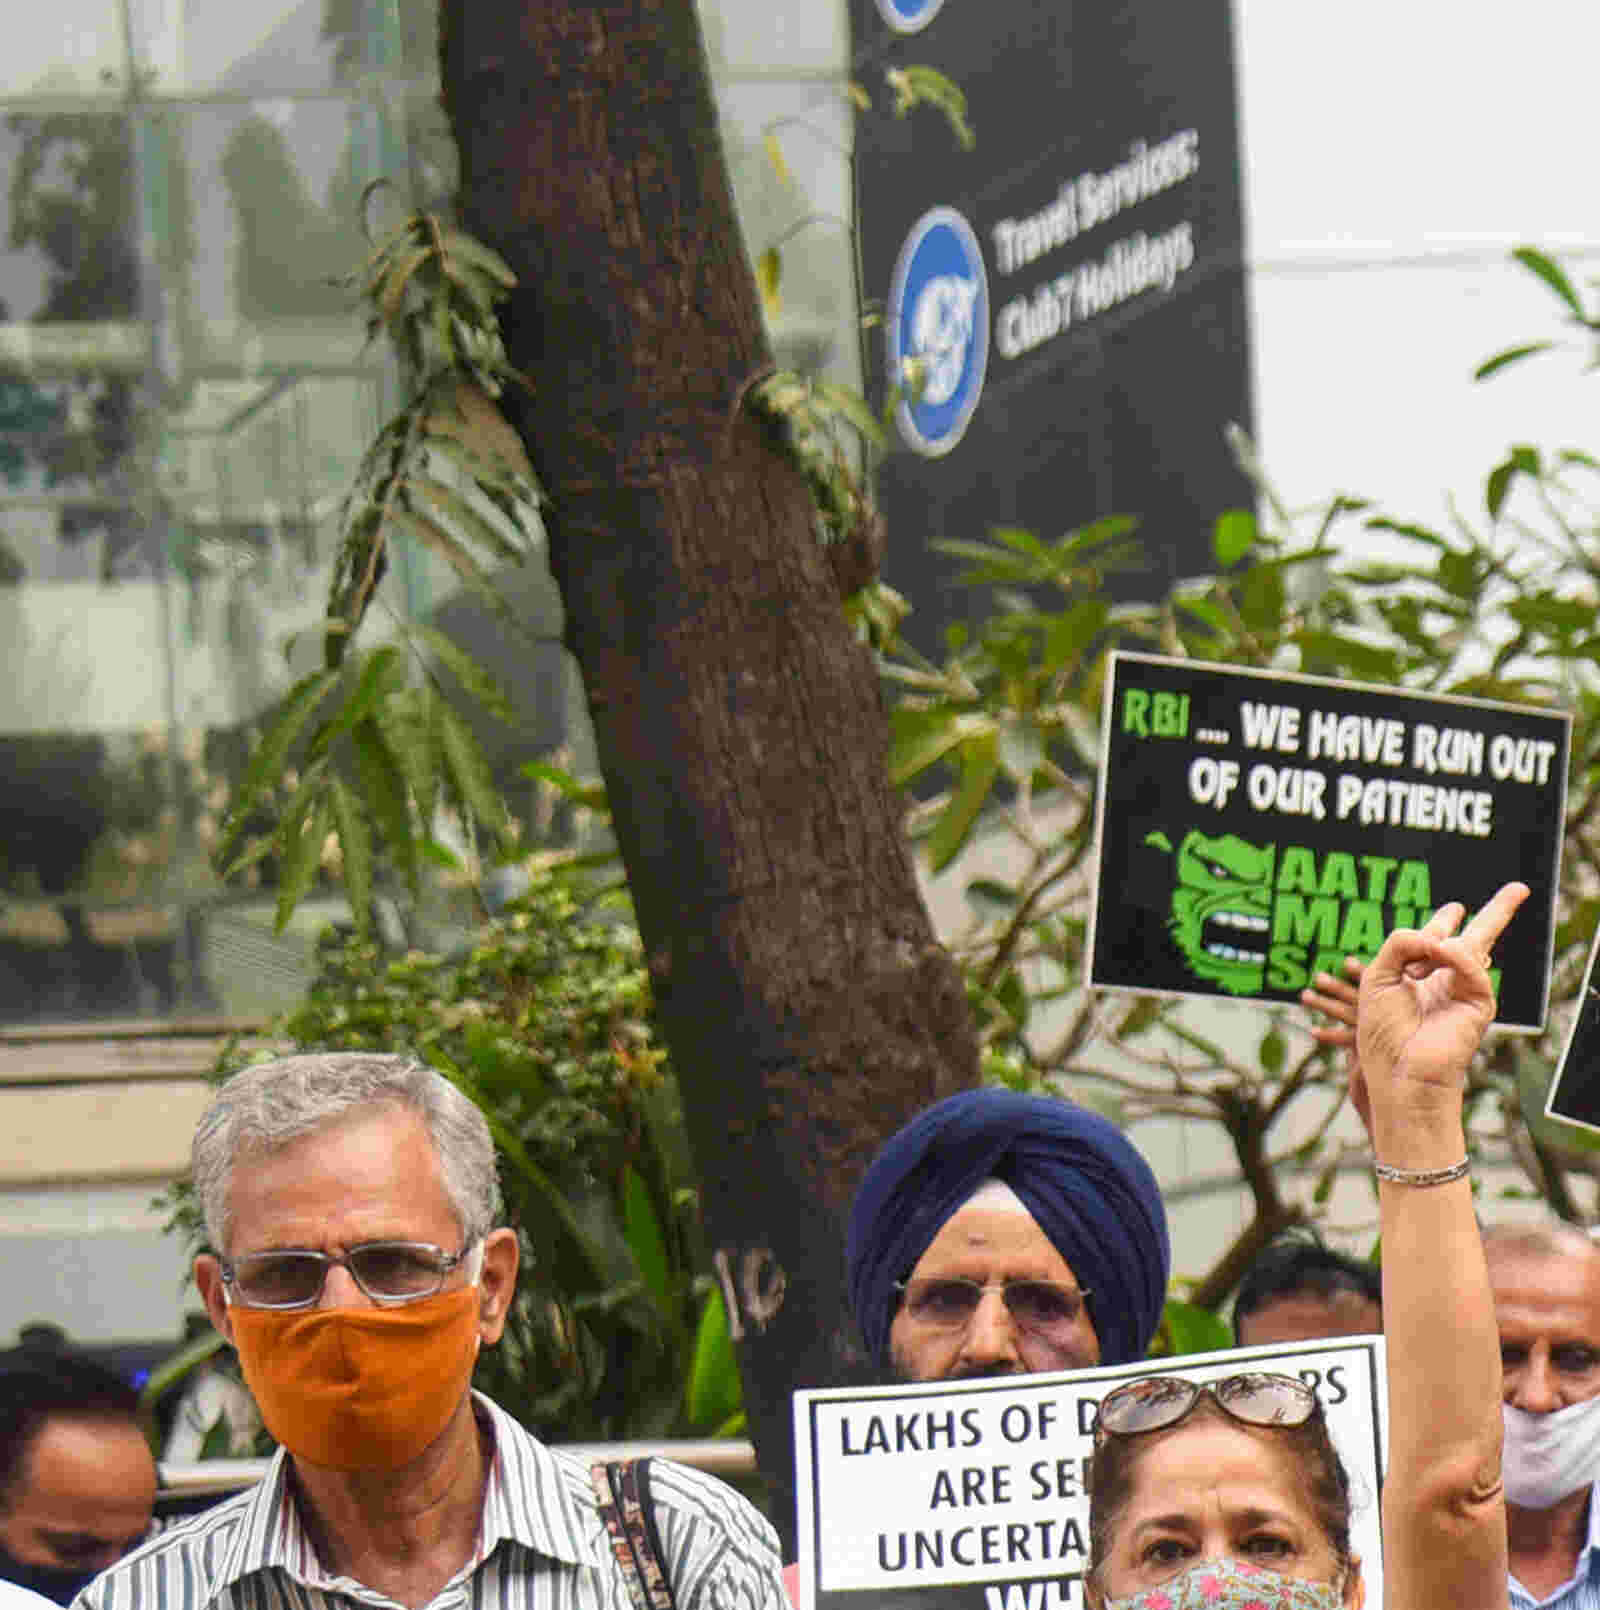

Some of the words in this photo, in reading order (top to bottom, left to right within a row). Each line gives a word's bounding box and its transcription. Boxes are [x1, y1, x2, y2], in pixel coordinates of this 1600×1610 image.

[993, 180, 1079, 273] Travel
[1070, 221, 1194, 321] Holidays
[1122, 688, 1190, 738] RBI
[1240, 701, 1300, 751] WE
[1307, 709, 1404, 767] HAVE
[1413, 723, 1484, 776] RUN
[1490, 736, 1555, 784] OUT
[1188, 757, 1239, 808] OF
[1248, 764, 1327, 820] OUR
[1336, 775, 1493, 836] PATIENCE
[1276, 846, 1431, 908] AATA
[840, 1407, 982, 1457] LAKHS
[1000, 1402, 1057, 1443] OF
[930, 1465, 1011, 1511] ARE
[877, 1517, 1089, 1573] UNCERTA
